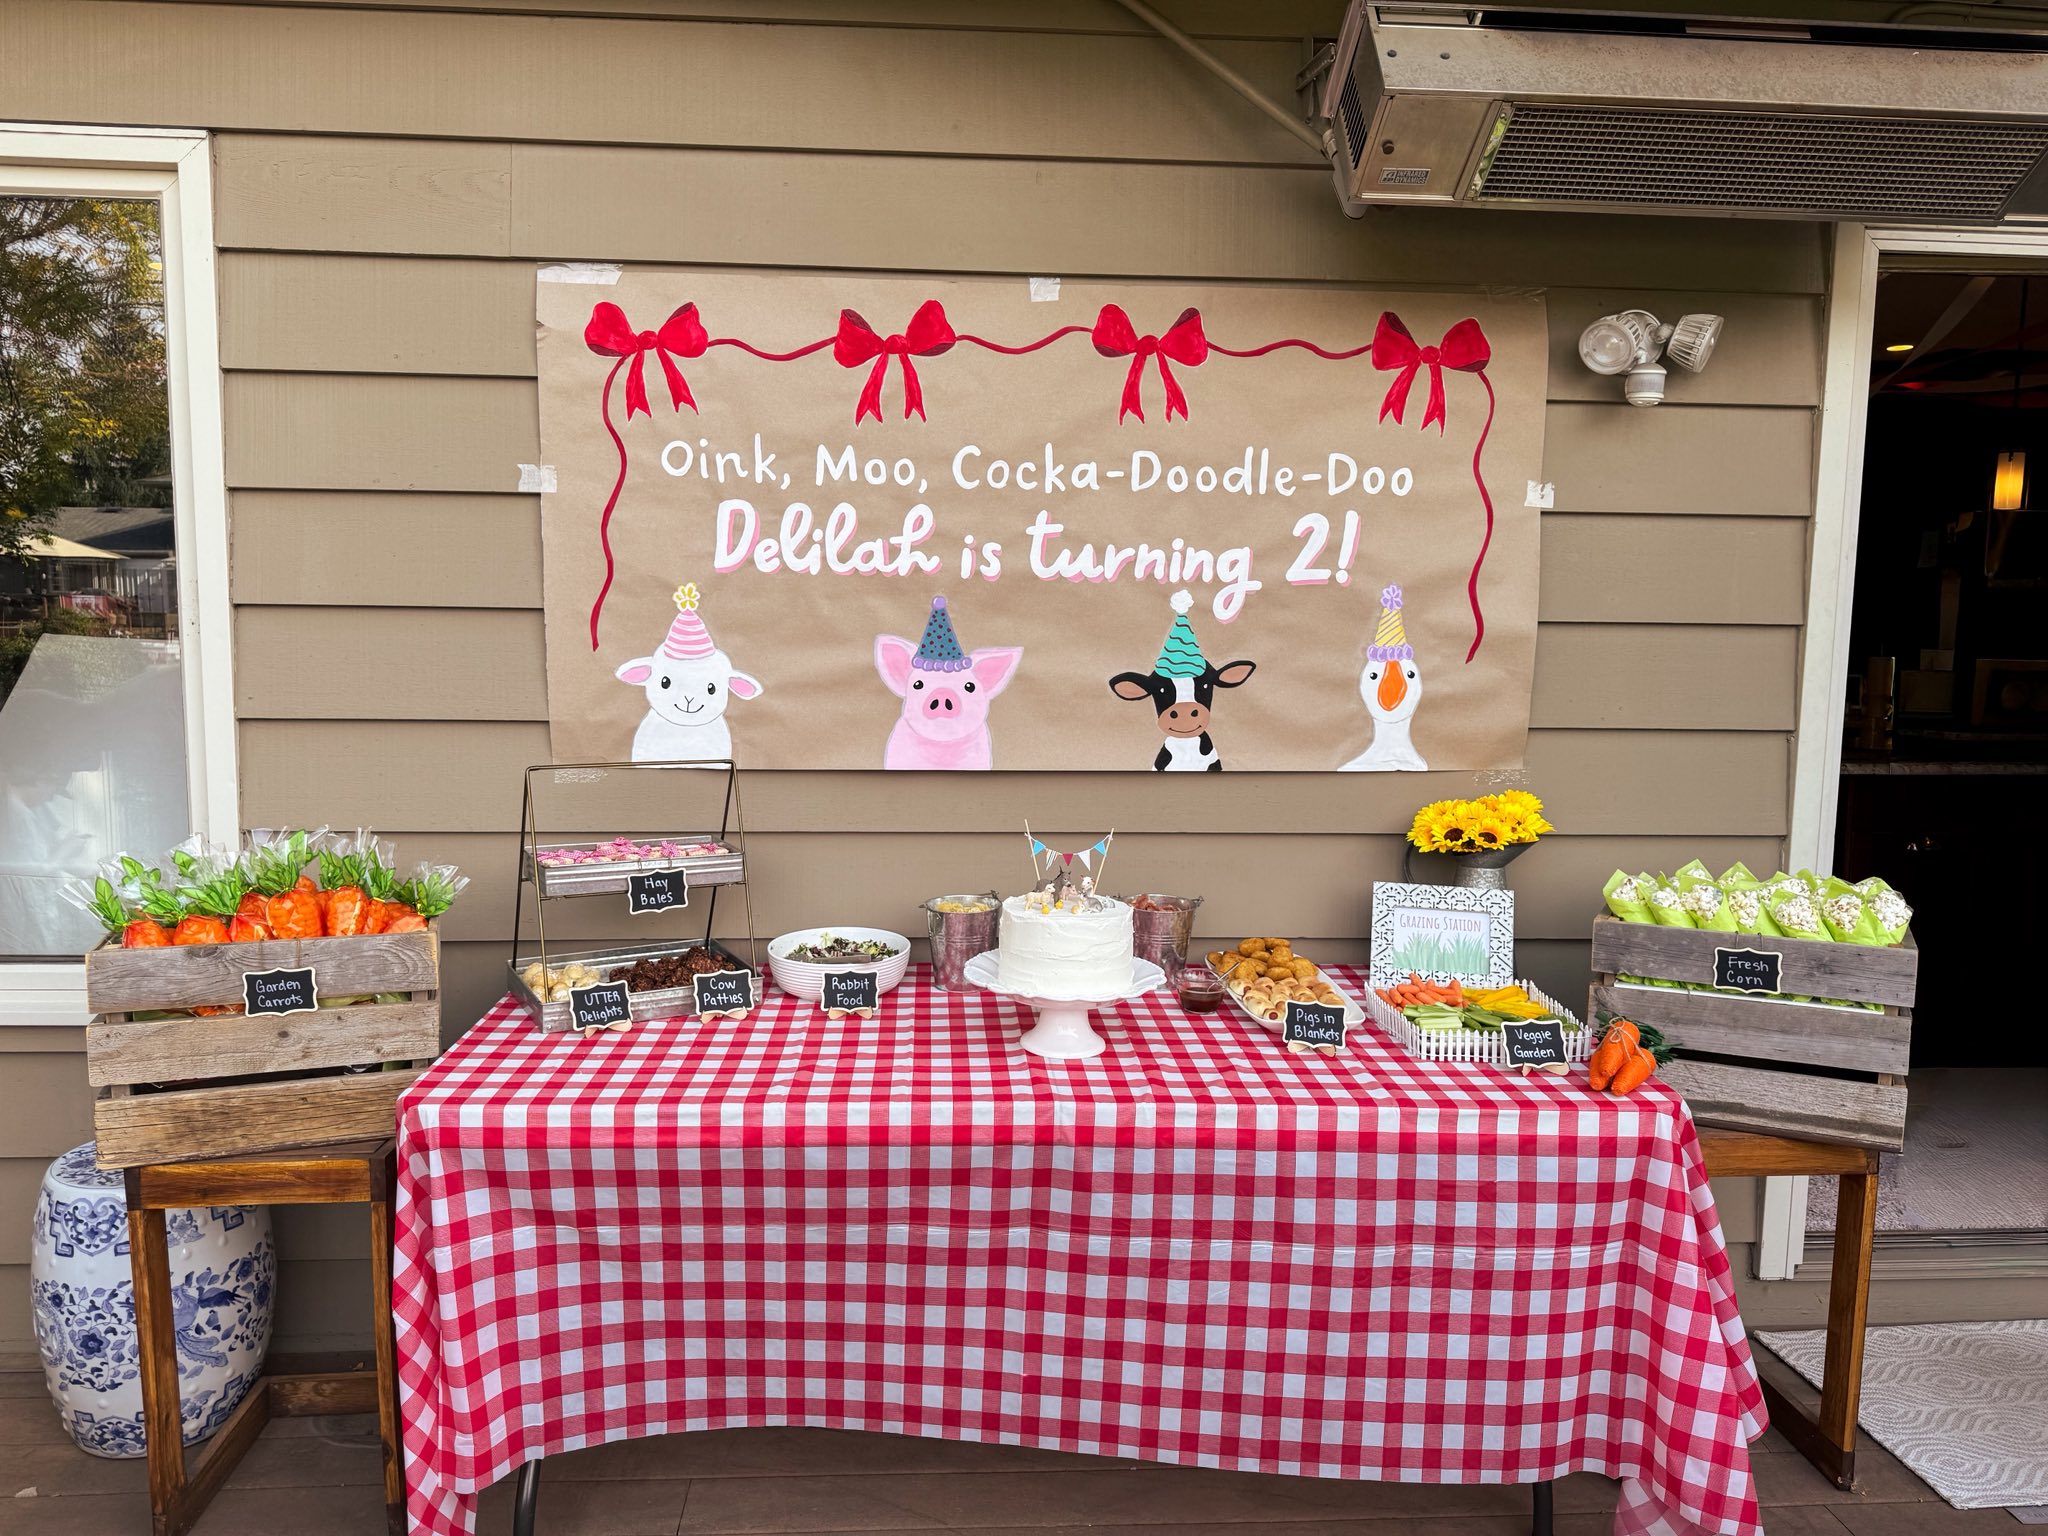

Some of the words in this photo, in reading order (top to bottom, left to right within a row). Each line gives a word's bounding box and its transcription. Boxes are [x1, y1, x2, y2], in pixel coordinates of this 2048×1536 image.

[661, 433, 791, 490] Oink,
[815, 444, 928, 493] Moo,
[952, 442, 1414, 496] Cocka-Doodle-Doo
[714, 499, 942, 577] Delilah
[960, 534, 1002, 582] is
[1026, 510, 1263, 624] turning
[1285, 510, 1361, 587] 2!
[644, 877, 668, 892] Hay
[640, 891, 673, 906] Bales
[1728, 956, 1769, 972] Fresh
[710, 977, 736, 990] Cow
[831, 976, 870, 990] Rabbit
[1726, 969, 1763, 986] Corn
[255, 979, 301, 994] Garden
[257, 994, 304, 1008] Carrots
[584, 991, 621, 1006] UTTER
[703, 992, 744, 1006] Patties
[836, 993, 864, 1006] Food
[579, 1005, 623, 1022] Delights
[1296, 1008, 1320, 1027] Pigs
[1323, 1013, 1335, 1024] in
[1514, 1028, 1553, 1045] Veggie
[1513, 1044, 1556, 1059] Garden
